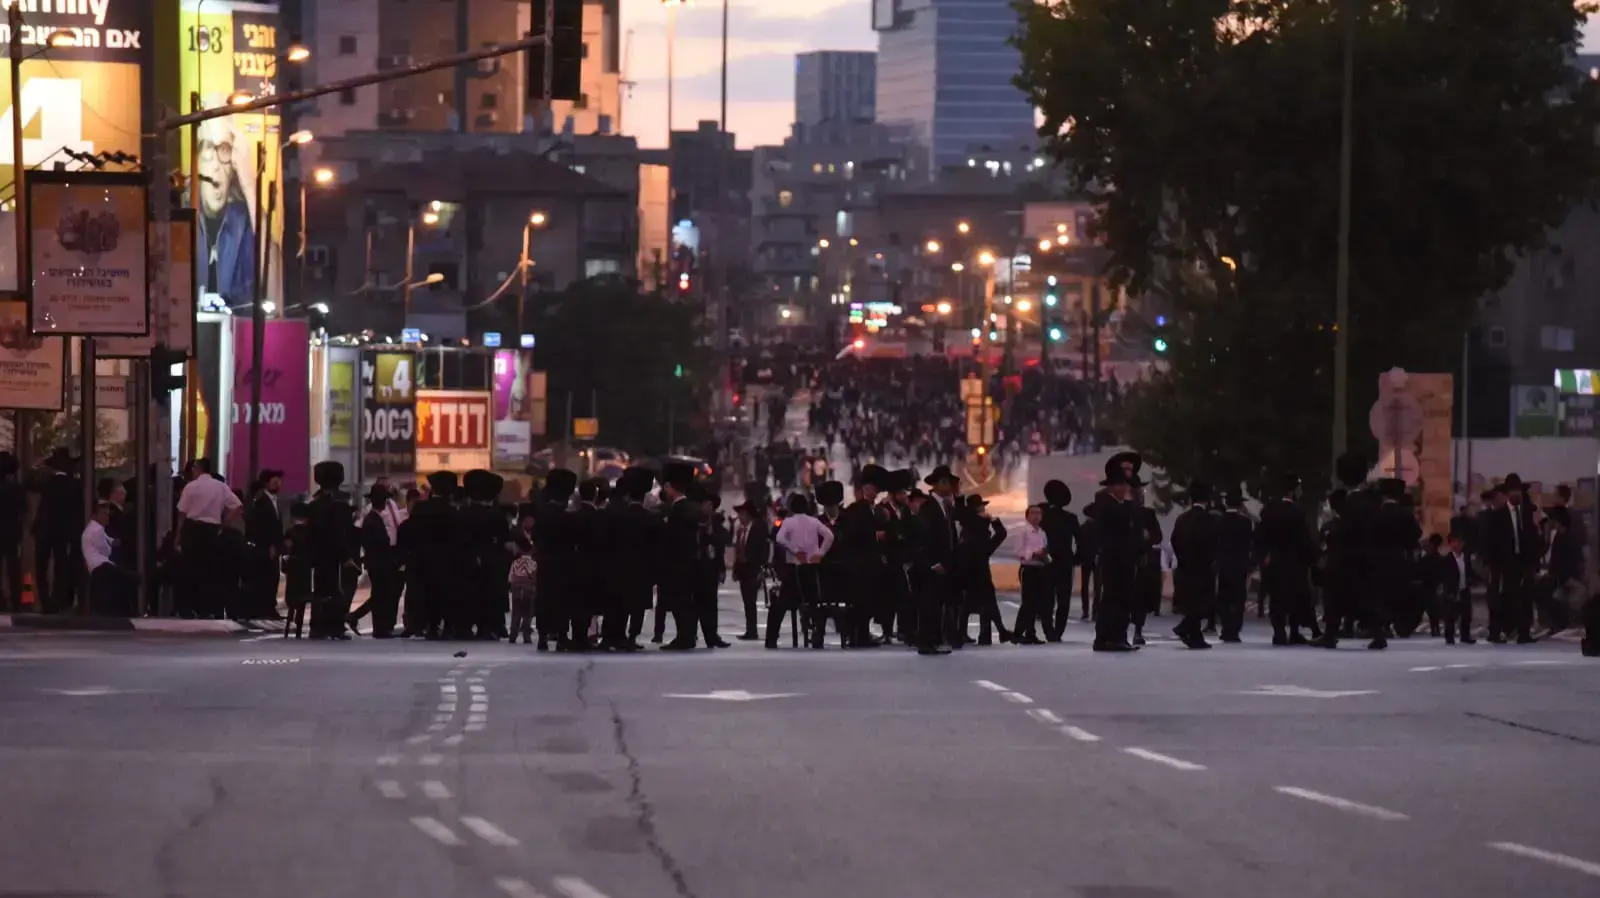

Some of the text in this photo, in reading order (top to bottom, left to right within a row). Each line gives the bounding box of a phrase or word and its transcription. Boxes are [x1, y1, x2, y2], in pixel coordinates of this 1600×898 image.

[106, 29, 141, 49] אם
[0, 77, 94, 171] 4
[393, 360, 410, 398] 4
